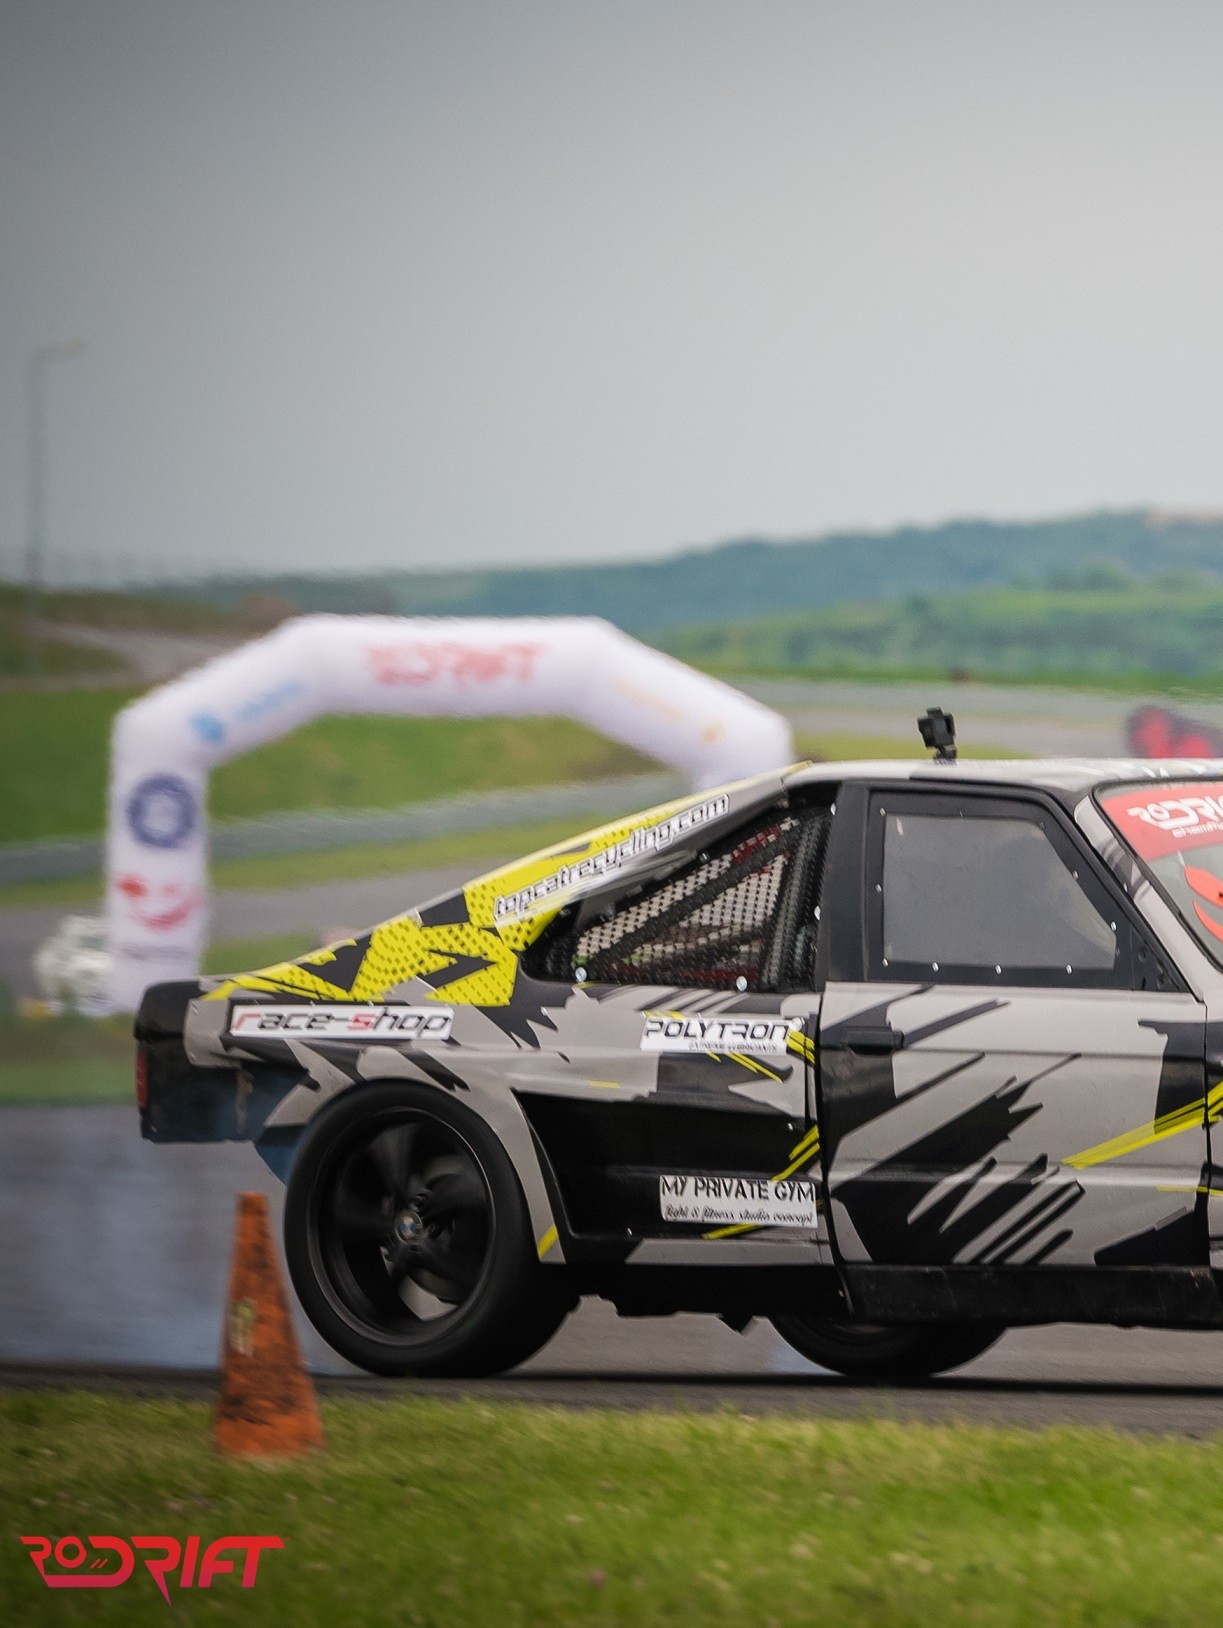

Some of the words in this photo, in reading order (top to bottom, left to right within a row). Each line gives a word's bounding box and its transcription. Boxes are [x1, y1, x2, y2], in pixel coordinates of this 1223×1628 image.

[231, 1006, 453, 1038] race-shop
[645, 1020, 790, 1041] POLYTRON
[661, 1176, 688, 1196] MY
[692, 1177, 770, 1201] PRIVATE
[774, 1181, 816, 1203] GYM
